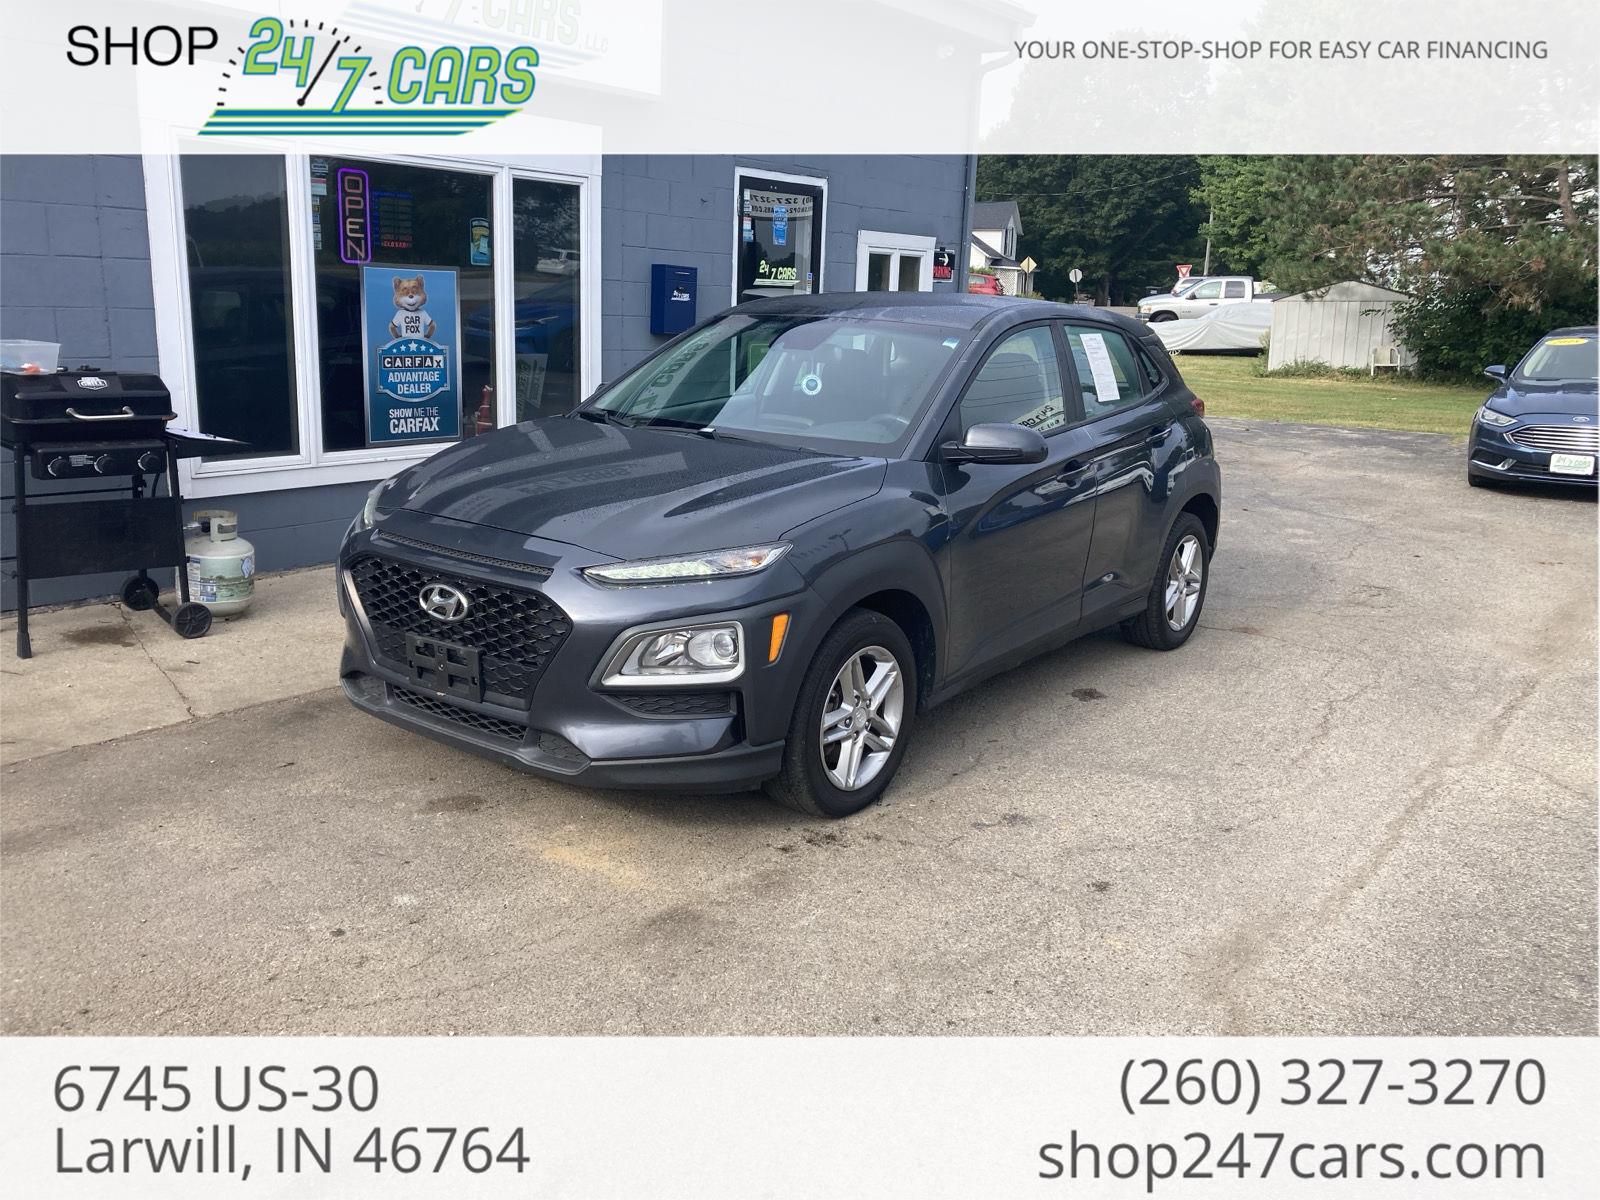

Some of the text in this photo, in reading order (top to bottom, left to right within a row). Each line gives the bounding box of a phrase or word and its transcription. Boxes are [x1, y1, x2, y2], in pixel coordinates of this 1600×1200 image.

[344, 175, 365, 258] OPEN
[777, 267, 797, 279] CARS
[404, 315, 421, 325] CAR
[405, 325, 421, 334] FOX
[384, 357, 443, 368] CARFAX
[388, 371, 440, 383] ADVANTAGE
[397, 383, 432, 394] DEALER
[389, 406, 439, 418] SHOW ME THE
[389, 417, 440, 434] CARFAX
